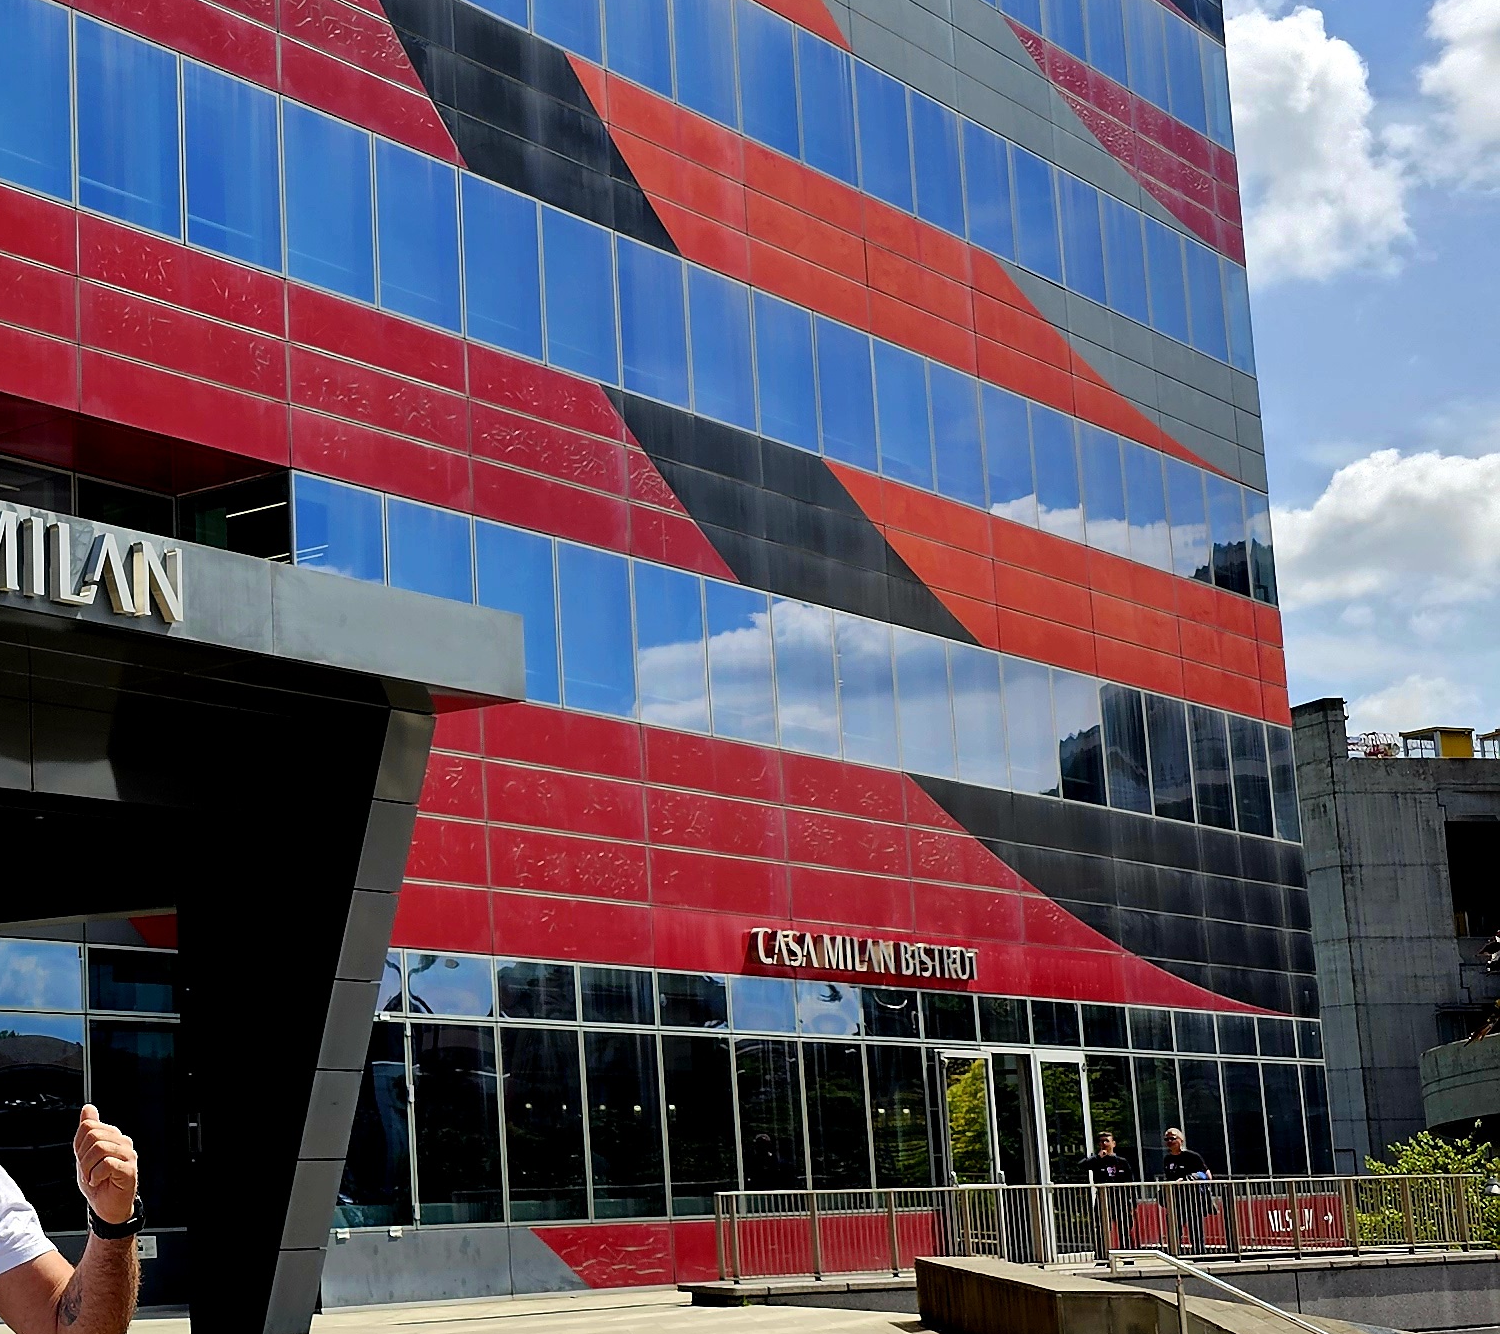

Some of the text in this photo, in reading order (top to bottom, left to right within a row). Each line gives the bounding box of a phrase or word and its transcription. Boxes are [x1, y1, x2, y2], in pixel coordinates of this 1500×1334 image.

[751, 927, 979, 981] CASA MILAN BISTROT
